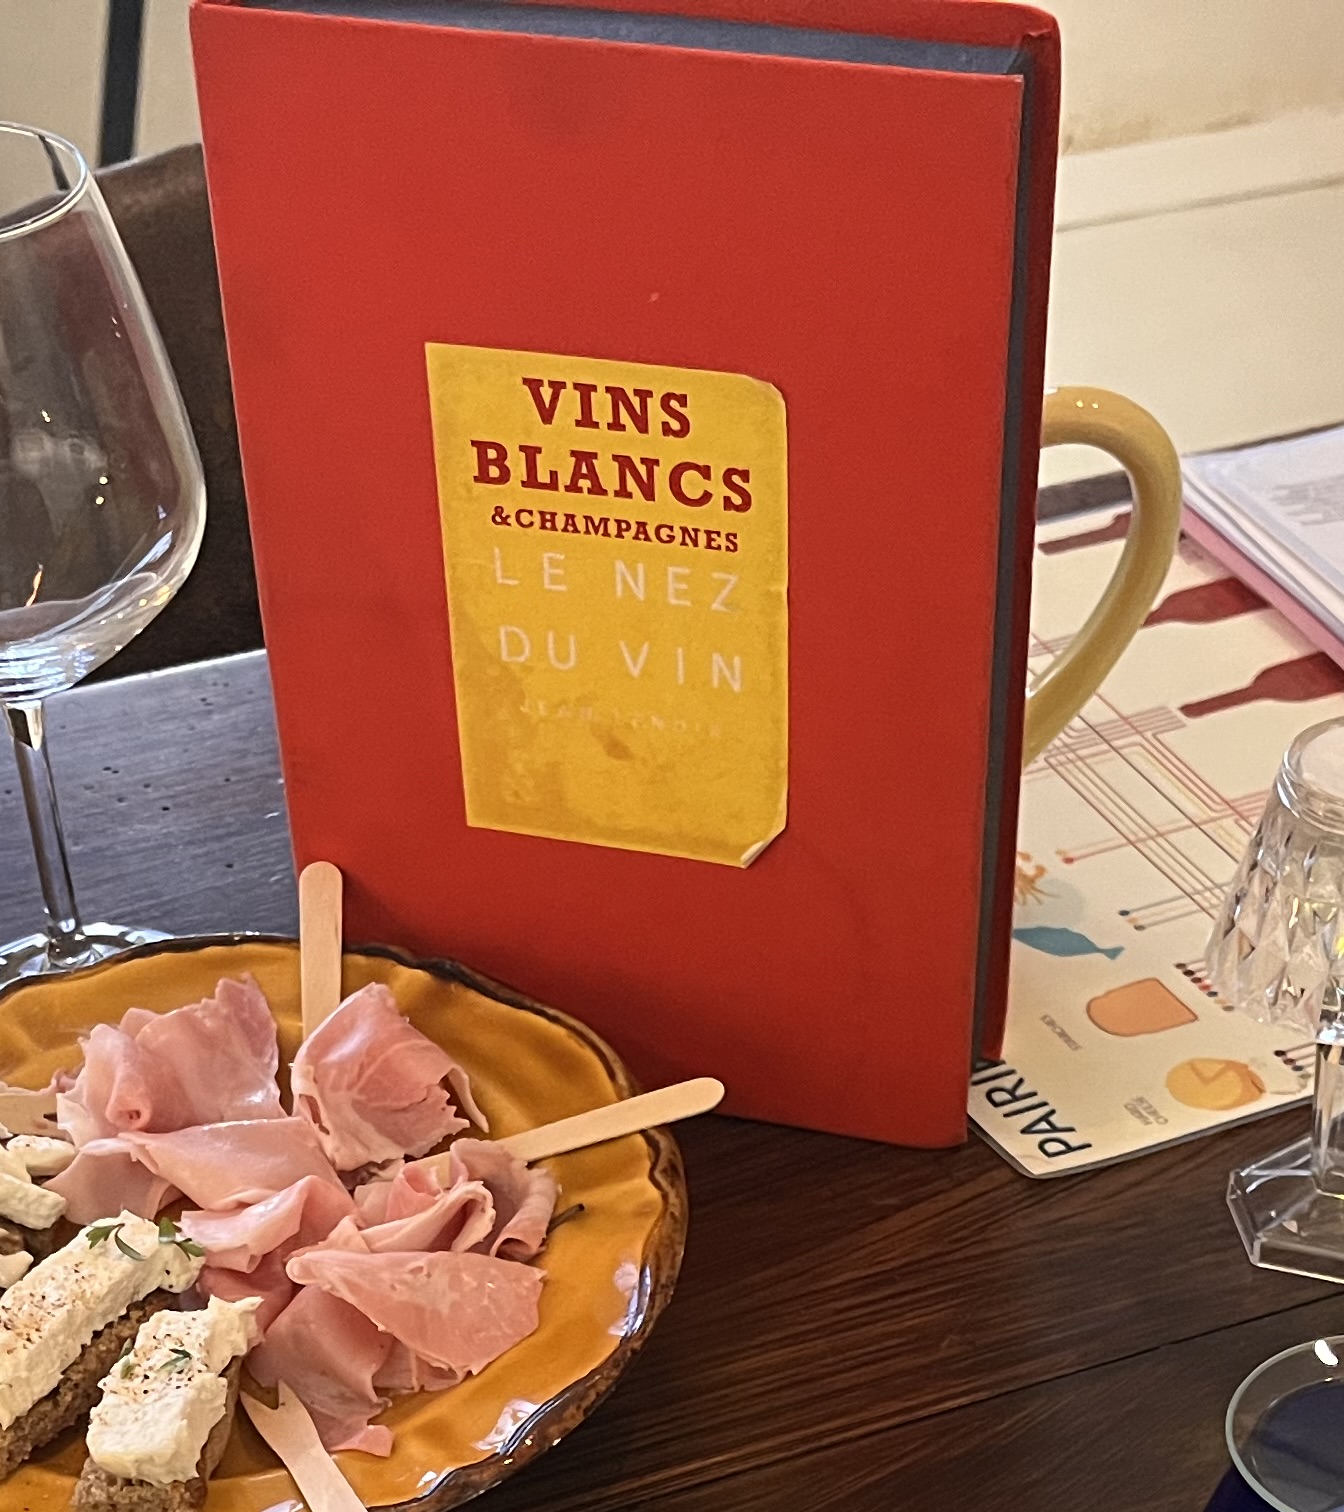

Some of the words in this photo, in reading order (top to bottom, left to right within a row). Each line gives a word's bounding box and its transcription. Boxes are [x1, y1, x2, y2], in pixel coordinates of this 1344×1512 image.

[522, 376, 691, 439] VINS
[470, 440, 753, 513] BLANCS
[491, 505, 740, 553] &CHAMPAGNES
[493, 547, 568, 592] LE
[614, 559, 740, 614] NEZ
[499, 625, 577, 671] DU
[619, 640, 743, 693] VIN
